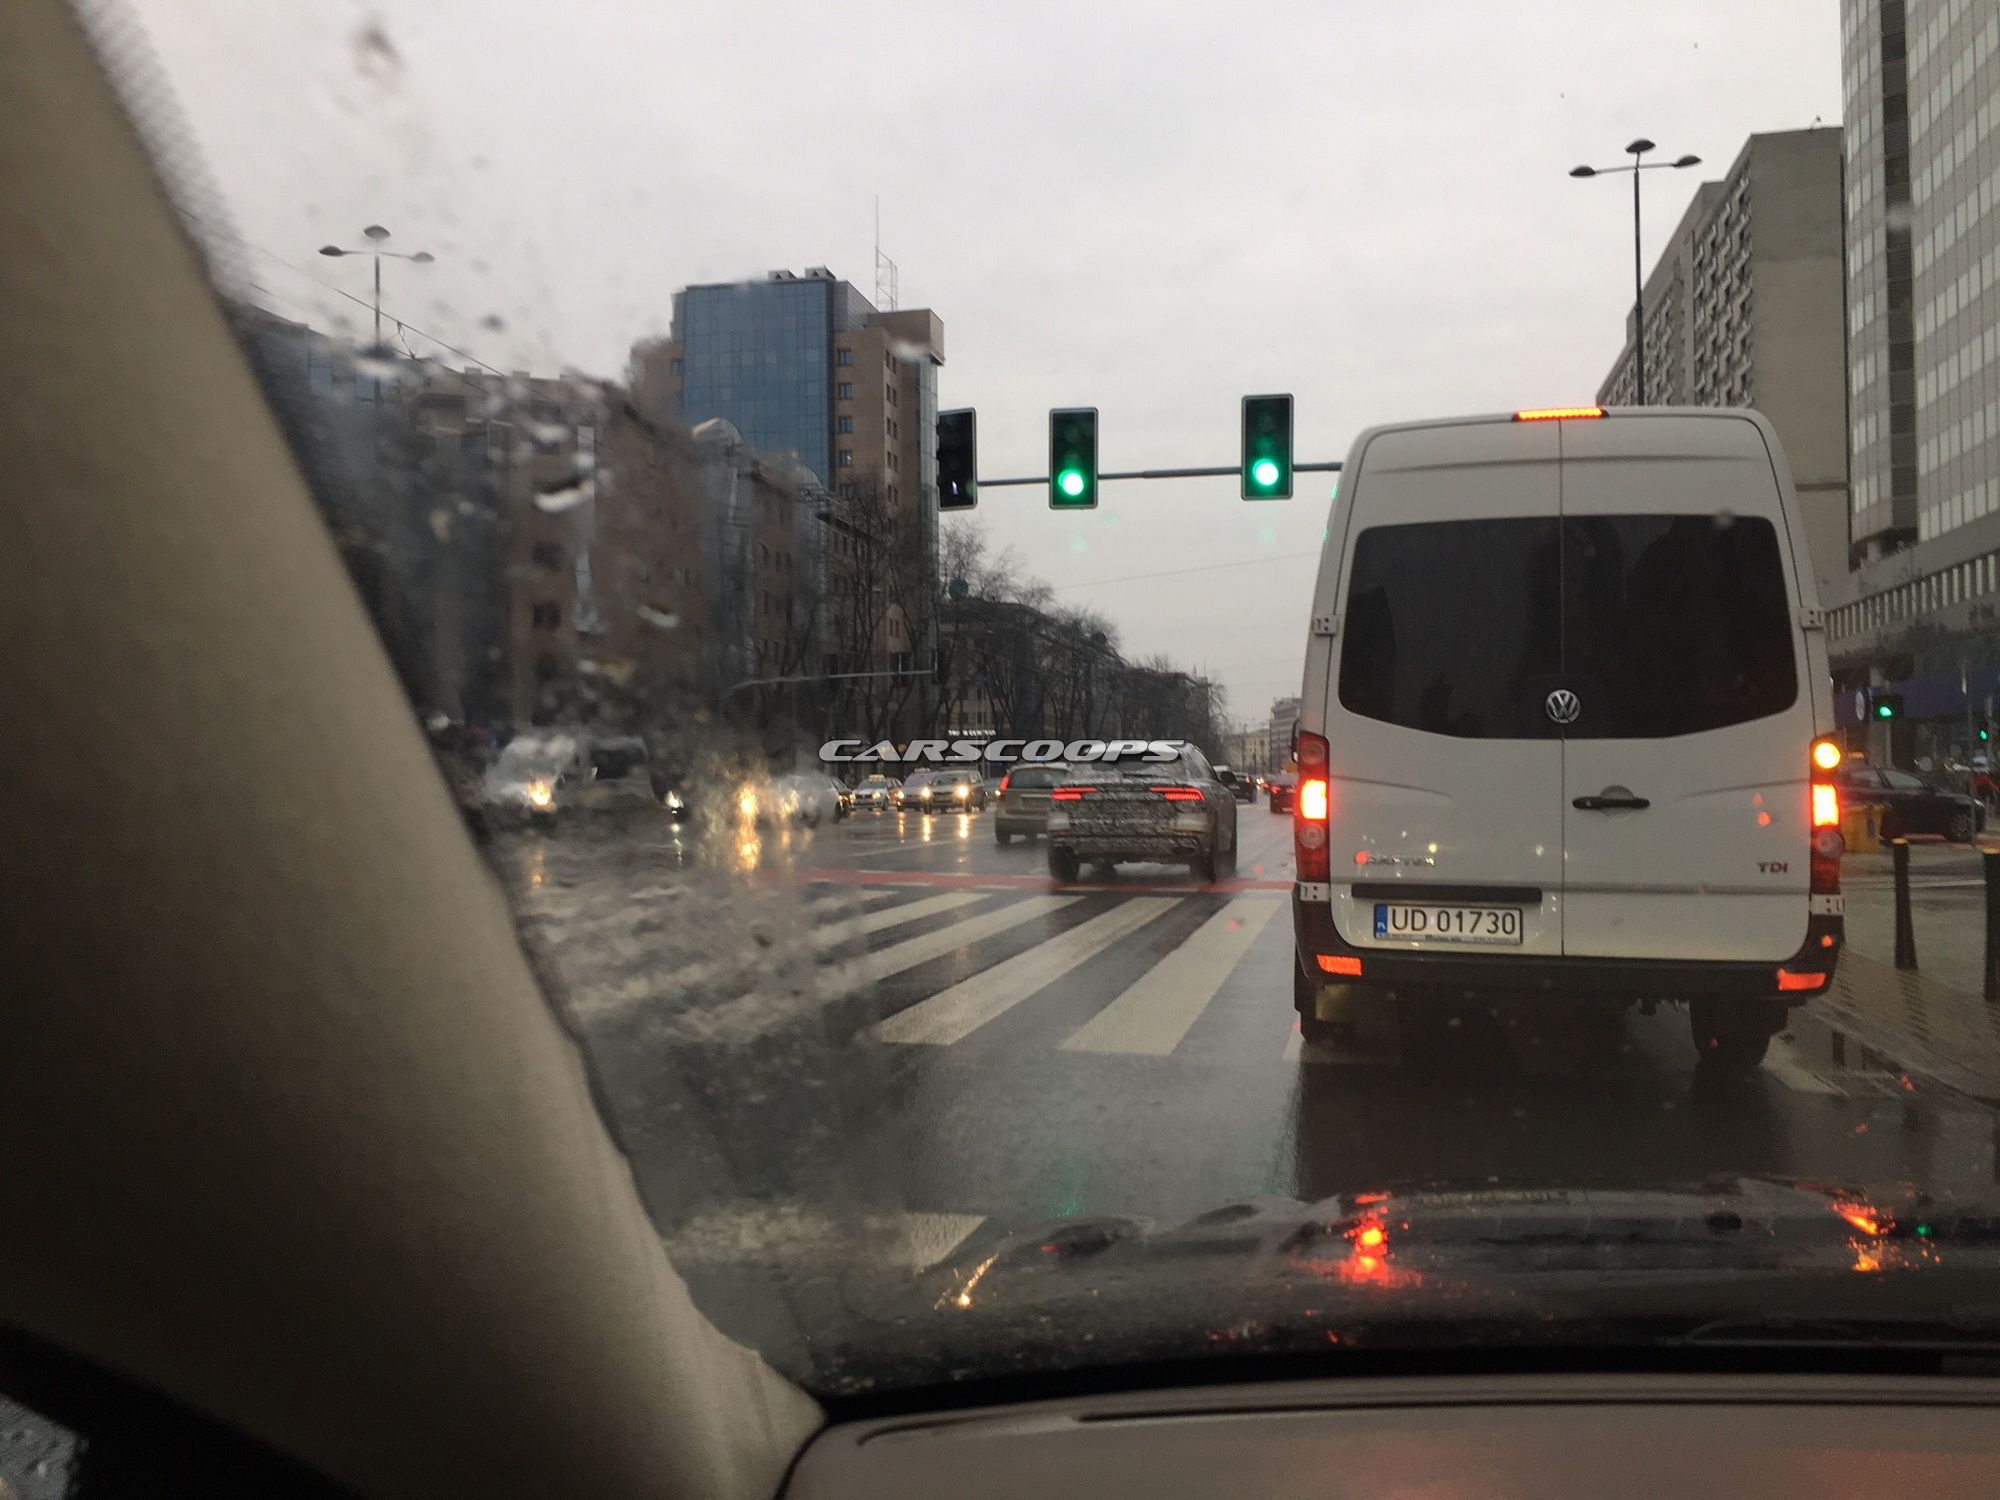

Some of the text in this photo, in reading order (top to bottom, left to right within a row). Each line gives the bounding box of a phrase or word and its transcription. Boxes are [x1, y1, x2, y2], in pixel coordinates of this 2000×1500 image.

[1757, 861, 1788, 873] TDI
[1391, 908, 1428, 932] UD
[1436, 909, 1517, 935] 01730
